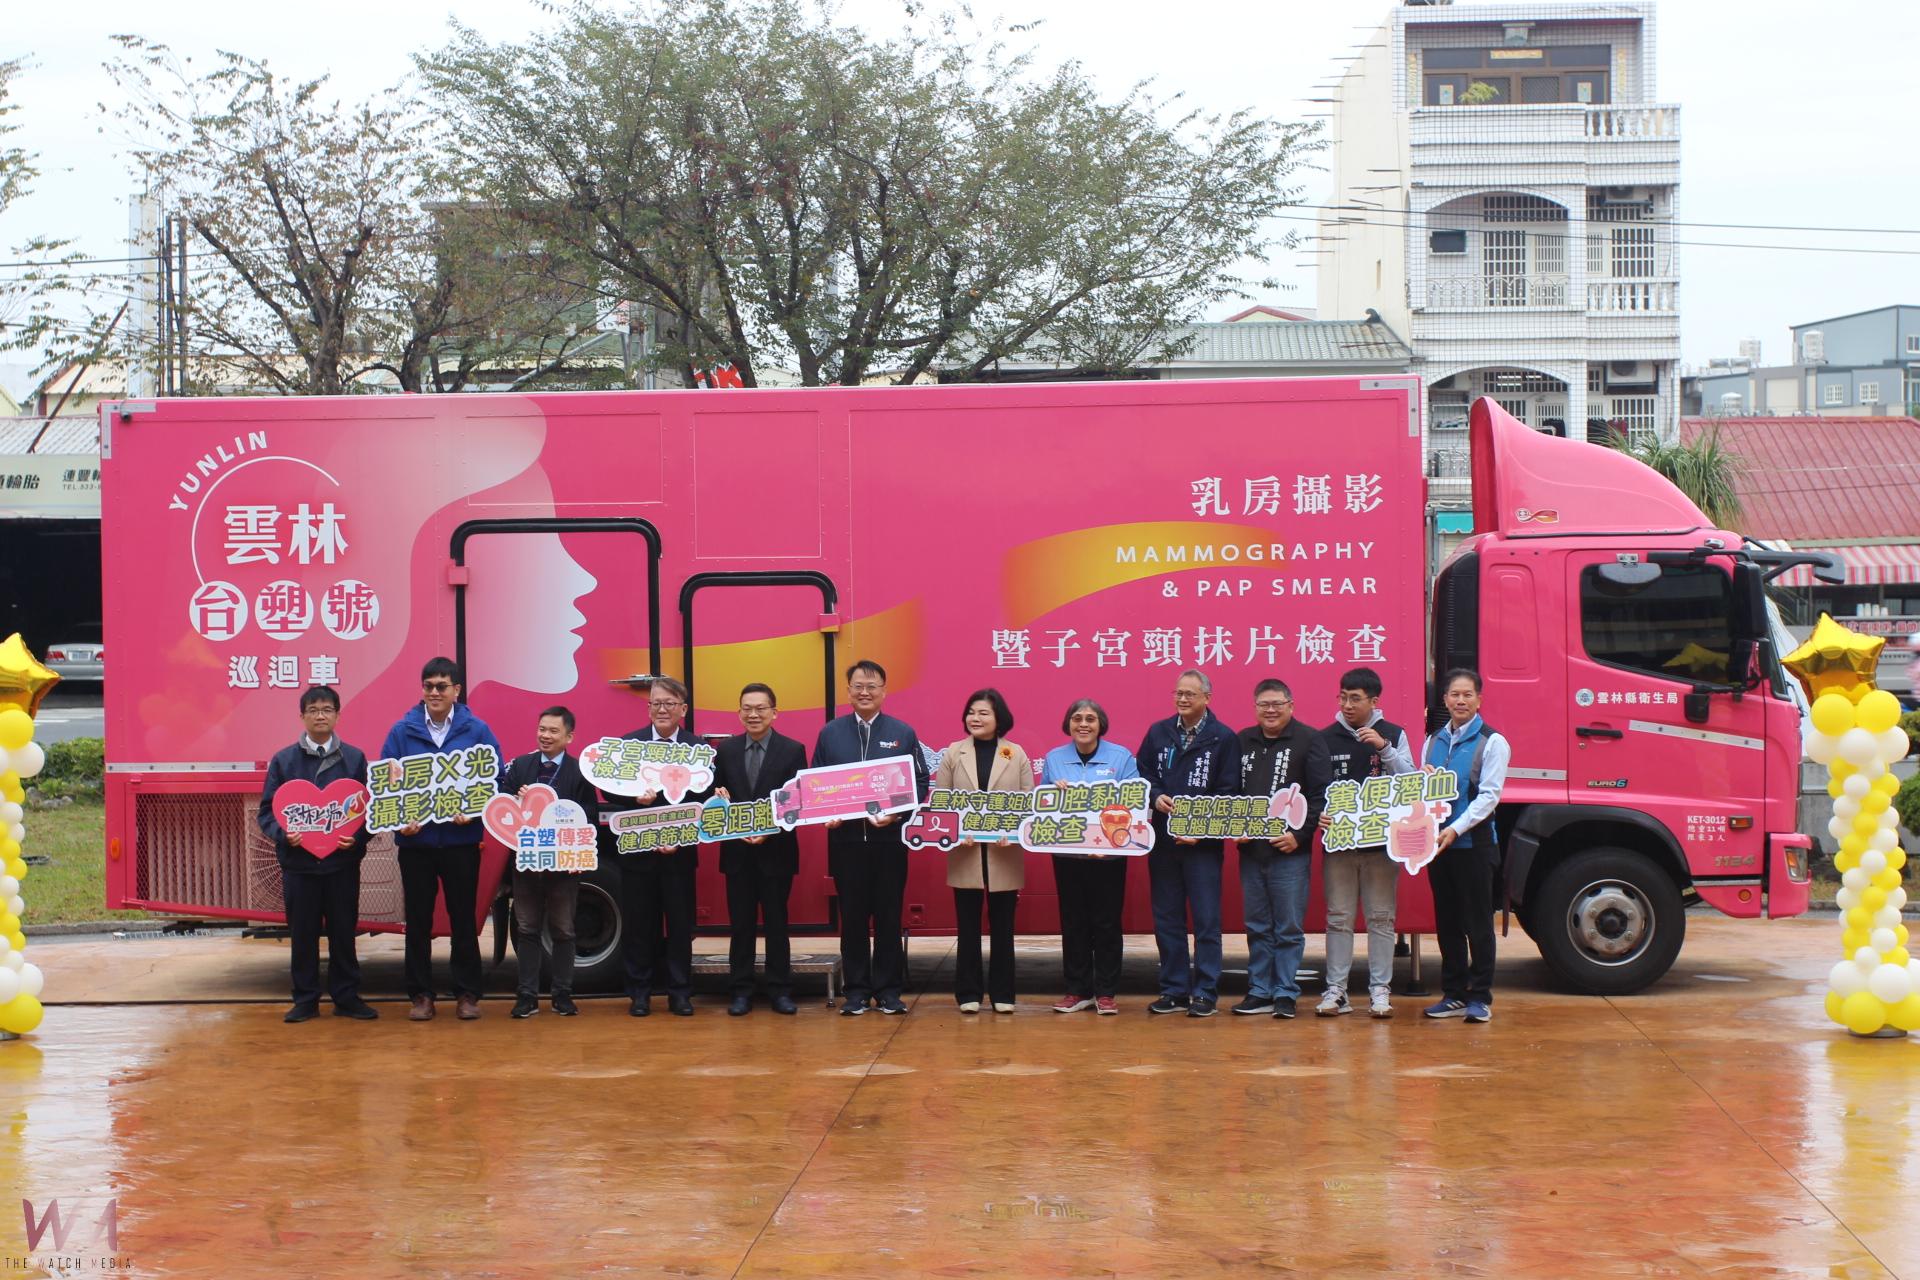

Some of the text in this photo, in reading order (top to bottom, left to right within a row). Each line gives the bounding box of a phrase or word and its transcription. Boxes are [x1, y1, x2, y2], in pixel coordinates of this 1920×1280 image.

[168, 430, 269, 513] YUNLIN
[1190, 472, 1385, 517] 乳房攝影
[222, 502, 349, 566] 雲林
[1115, 540, 1376, 564] MAMMOGRAPHY
[1162, 576, 1378, 598] & PAP SMEAR
[189, 580, 380, 641] 台塑號
[991, 623, 1389, 670] 暨子宮頸抹片檢查
[228, 653, 341, 689] 巡迴車
[1597, 692, 1679, 705] 雲林縣衛生局
[597, 738, 716, 768] 子宮頸抹片
[370, 747, 496, 795] 乳房X光
[592, 758, 641, 781] 檢查
[370, 782, 496, 830] 攝影檢查
[1034, 781, 1148, 813] 口腔黏膜
[1172, 797, 1270, 817] 胸部低劑量
[1326, 768, 1458, 816] 糞便潛血
[699, 799, 775, 837] 零距離
[1031, 815, 1086, 845] 檢查
[1169, 816, 1286, 836] 電腦斷層檢查
[1325, 812, 1390, 849] 檢查
[518, 827, 595, 847] 台塑傳愛
[619, 823, 699, 852] 健康篩檢
[518, 849, 596, 871] 共同防癌
